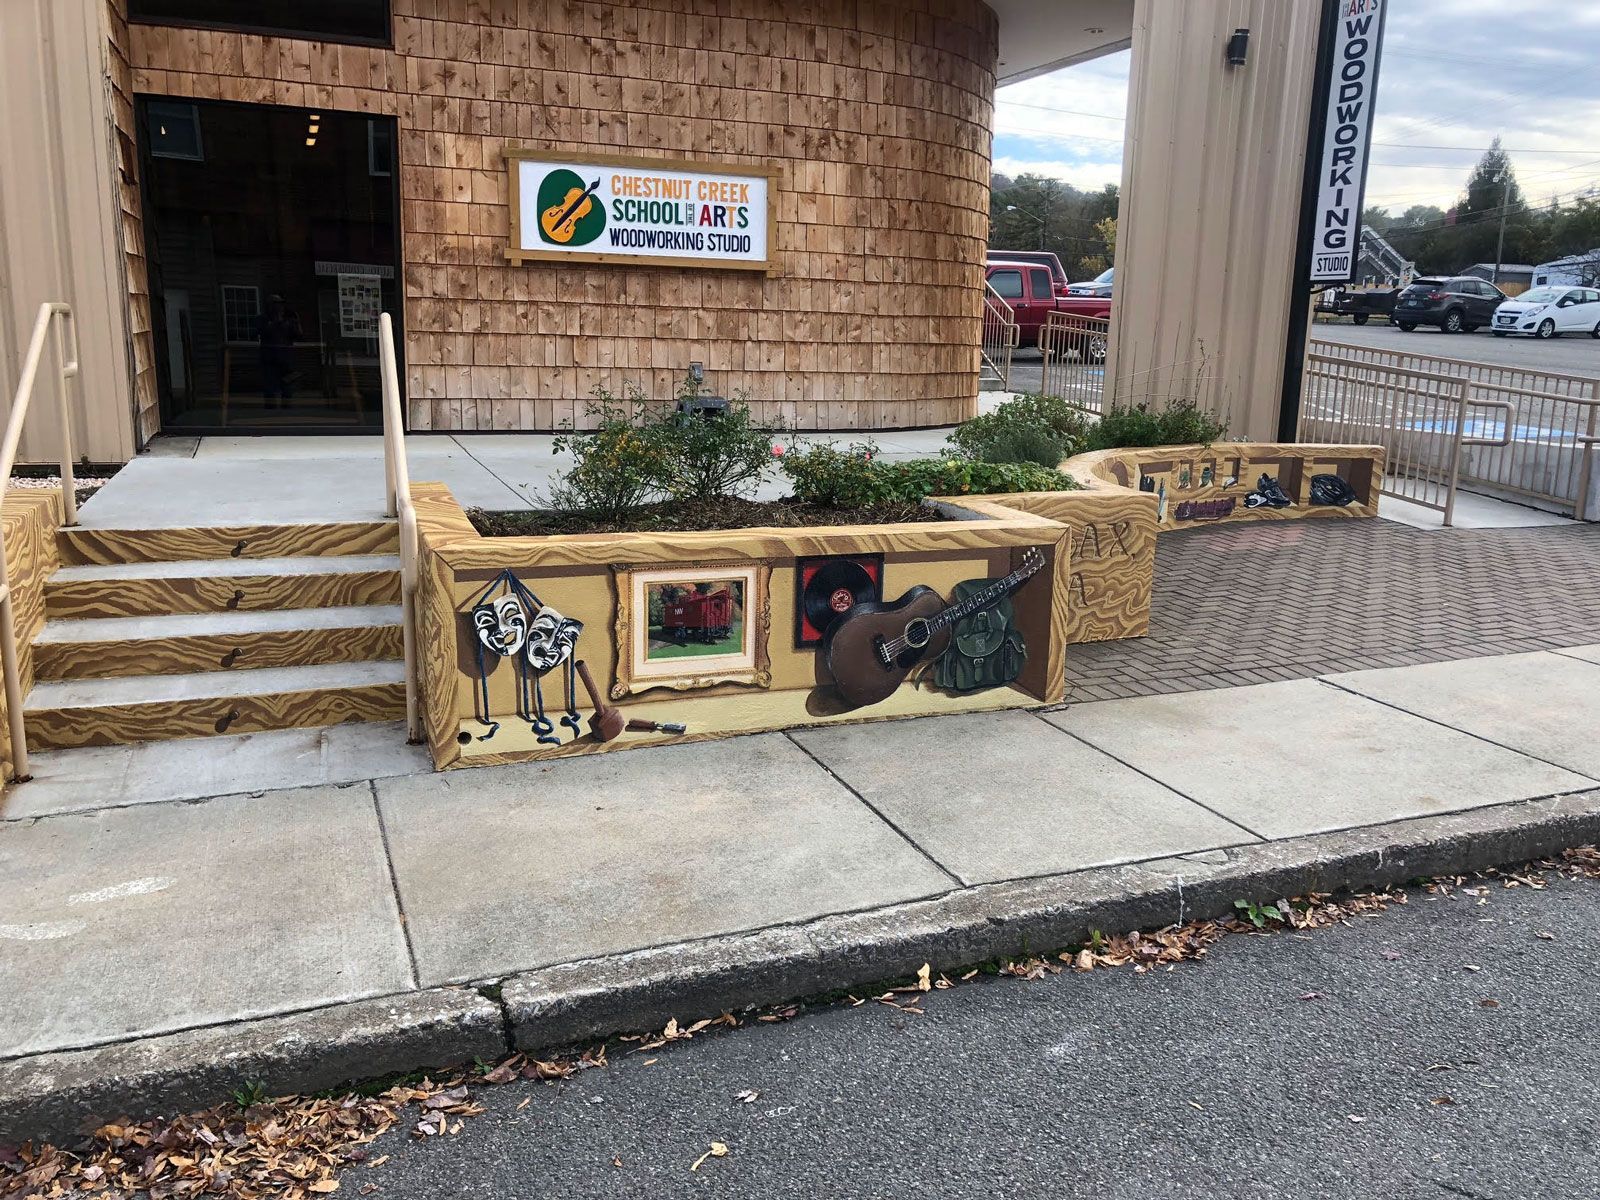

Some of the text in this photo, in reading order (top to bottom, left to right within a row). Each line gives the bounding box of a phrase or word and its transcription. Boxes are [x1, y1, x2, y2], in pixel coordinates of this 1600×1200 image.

[1323, 14, 1373, 249] WOODWORKING
[610, 174, 749, 204] CHESTNUT CREEK
[612, 198, 684, 226] SCHOOL
[699, 204, 749, 229] ARTS
[609, 227, 751, 253] WOODWORKING STUDIO
[1316, 256, 1348, 273] STUDIO
